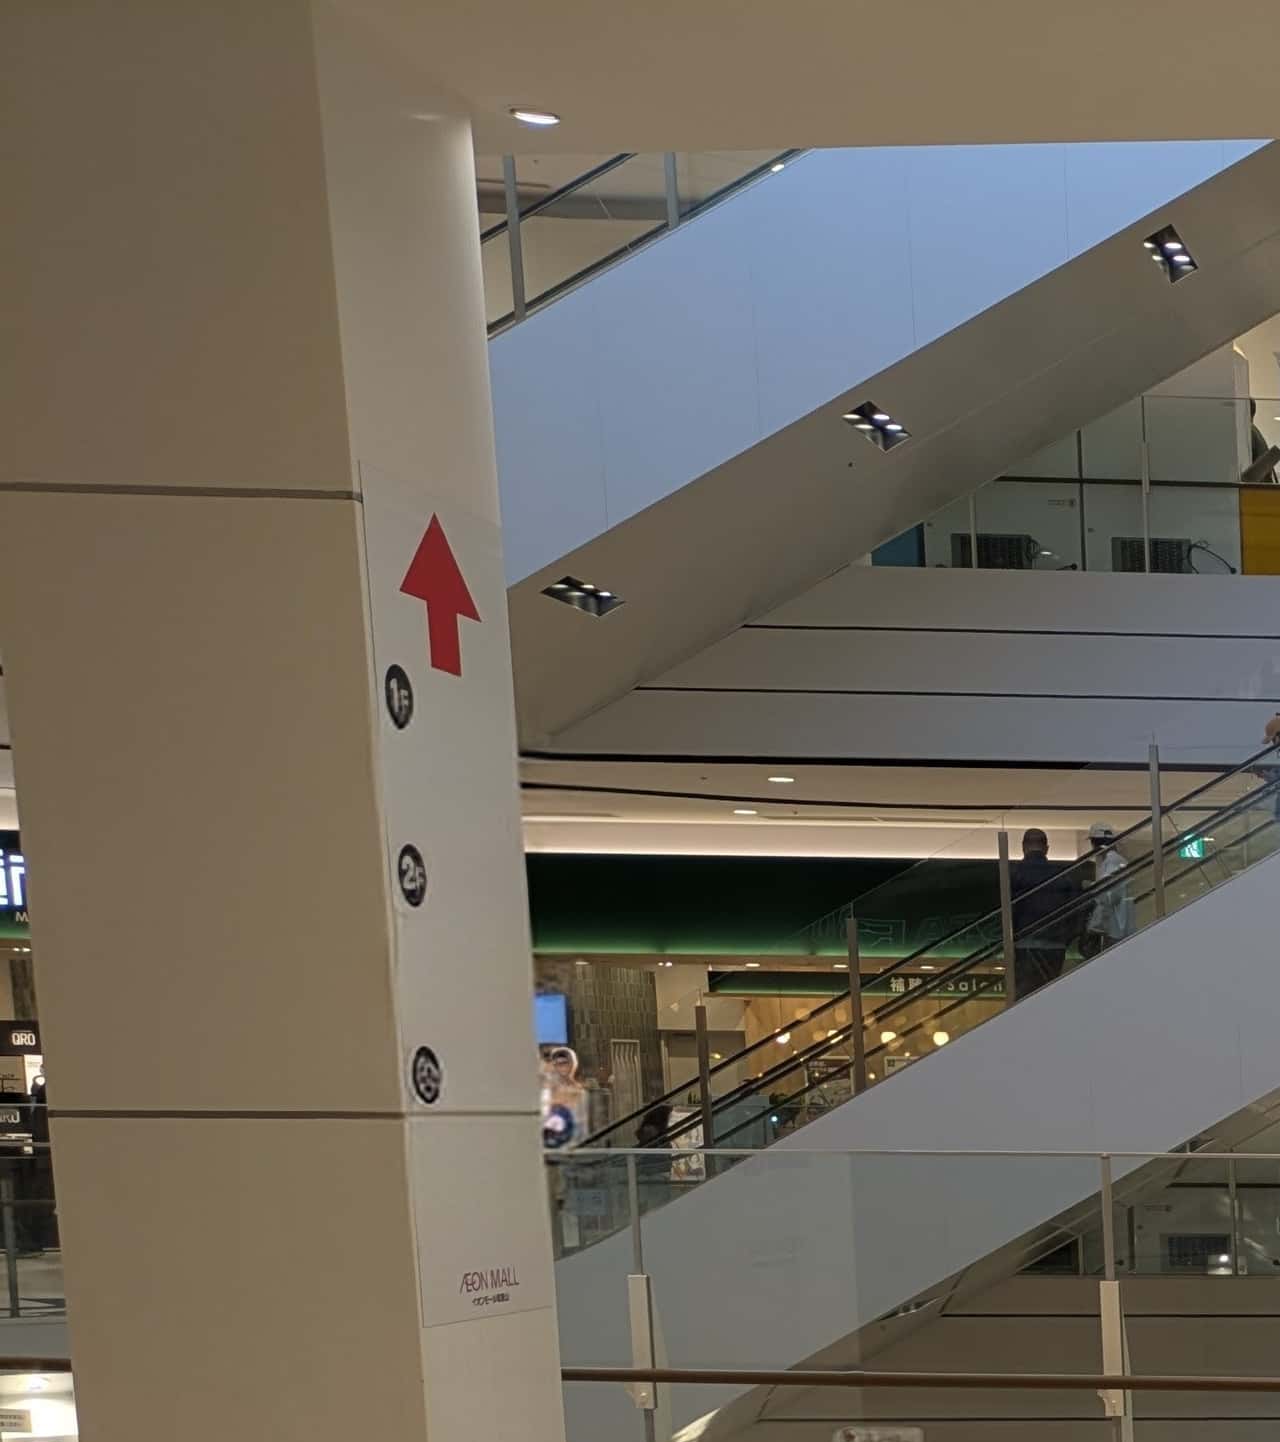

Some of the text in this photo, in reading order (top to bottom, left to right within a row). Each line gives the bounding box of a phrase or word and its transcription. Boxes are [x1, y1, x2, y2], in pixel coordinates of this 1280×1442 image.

[389, 677, 409, 706] 1F
[401, 853, 425, 889] 2F
[490, 1264, 520, 1289] MALL
